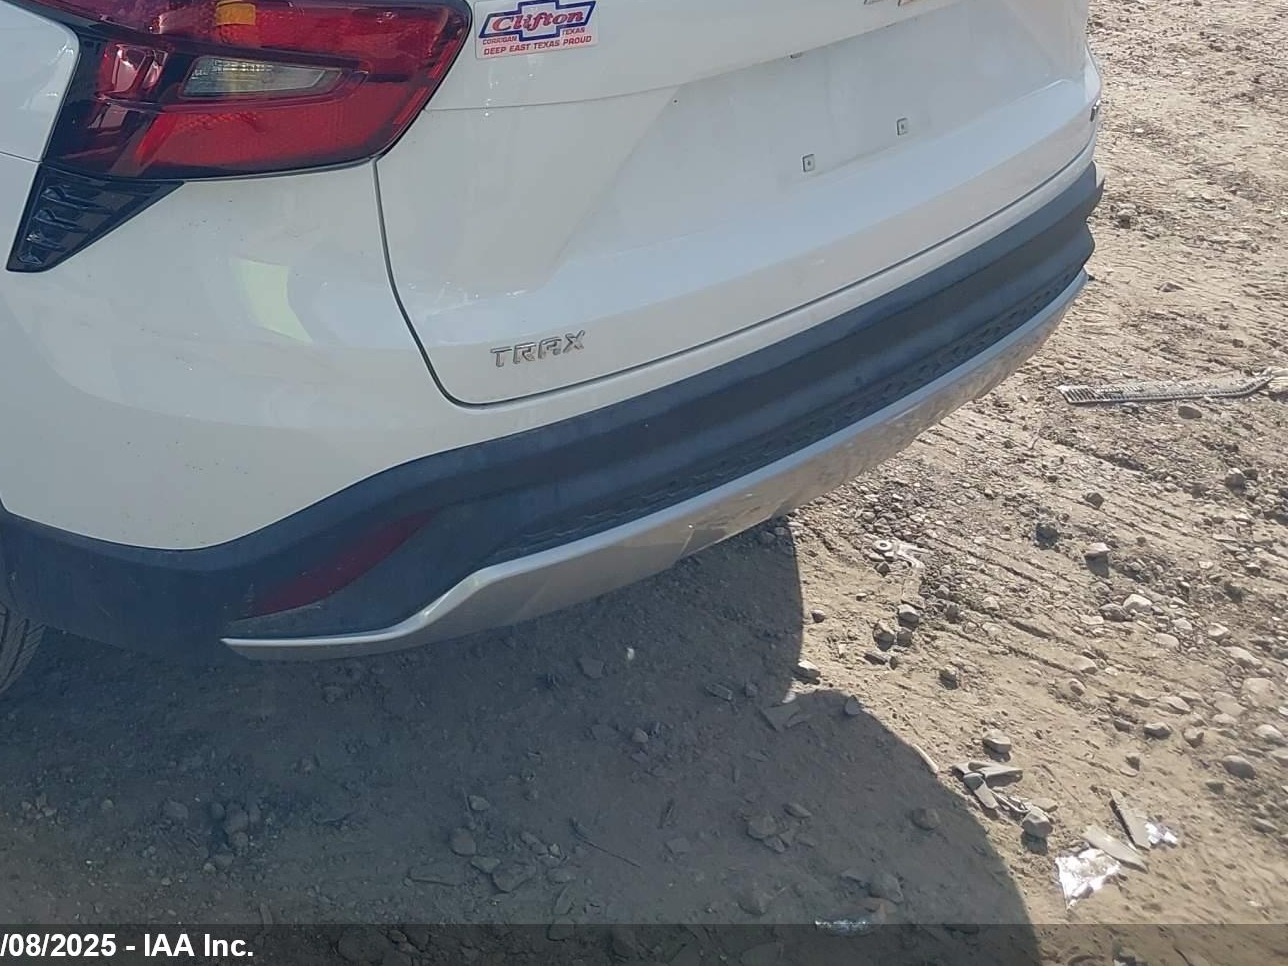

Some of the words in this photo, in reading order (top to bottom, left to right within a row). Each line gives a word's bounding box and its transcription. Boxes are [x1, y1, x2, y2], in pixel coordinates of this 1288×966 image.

[492, 11, 584, 32] Clifton
[562, 27, 585, 36] TEXAS
[483, 46, 507, 56] DEEP
[509, 44, 531, 52] EAST
[534, 40, 560, 50] TEXAS
[562, 35, 592, 46] PROUD
[490, 329, 585, 368] TRAX
